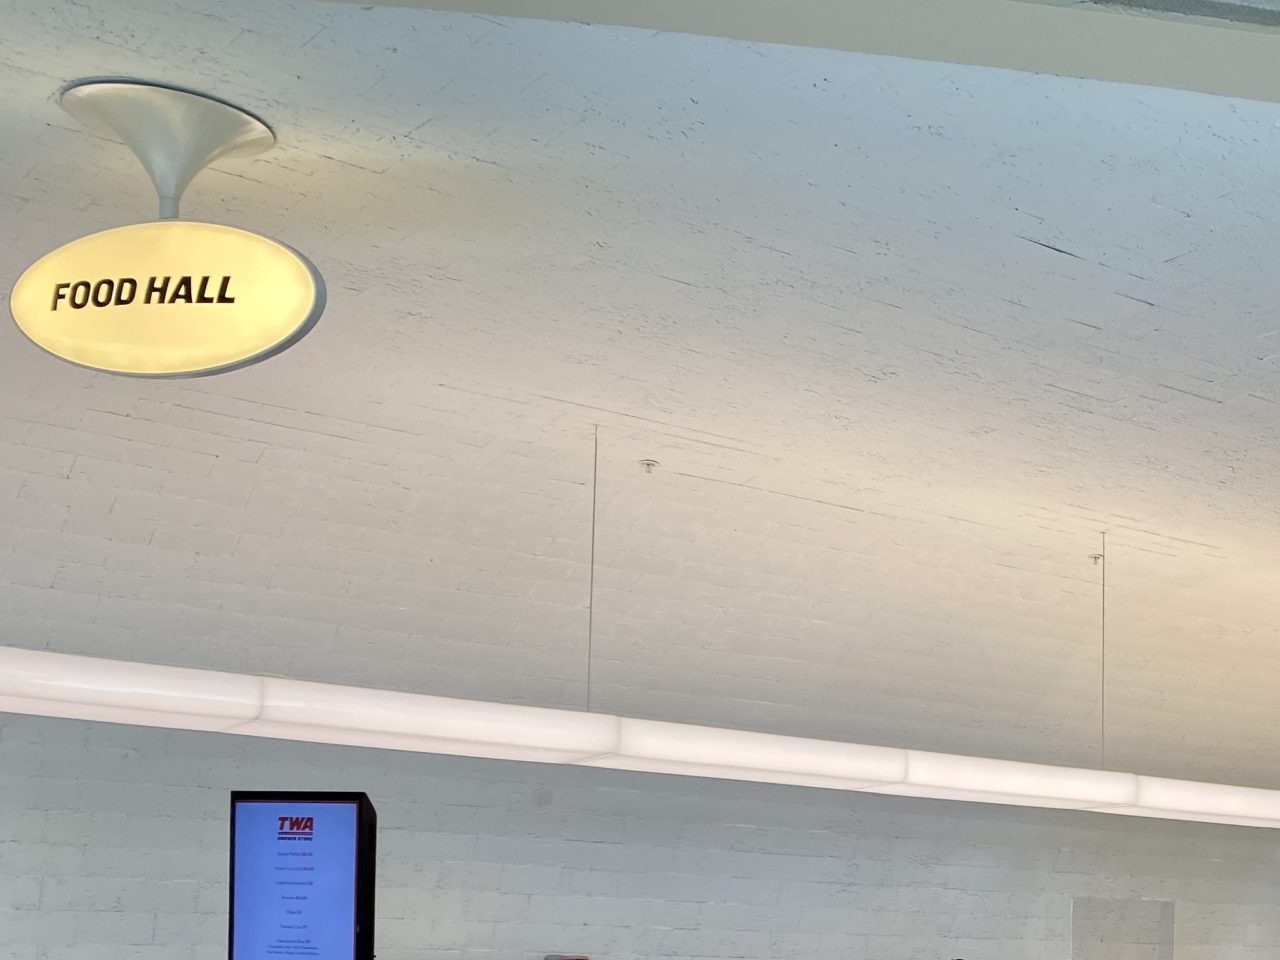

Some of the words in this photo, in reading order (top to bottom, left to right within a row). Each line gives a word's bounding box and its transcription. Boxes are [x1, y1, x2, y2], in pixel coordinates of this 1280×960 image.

[50, 278, 138, 311] FOOD
[143, 275, 236, 305] HALL
[277, 816, 314, 831] TWA
